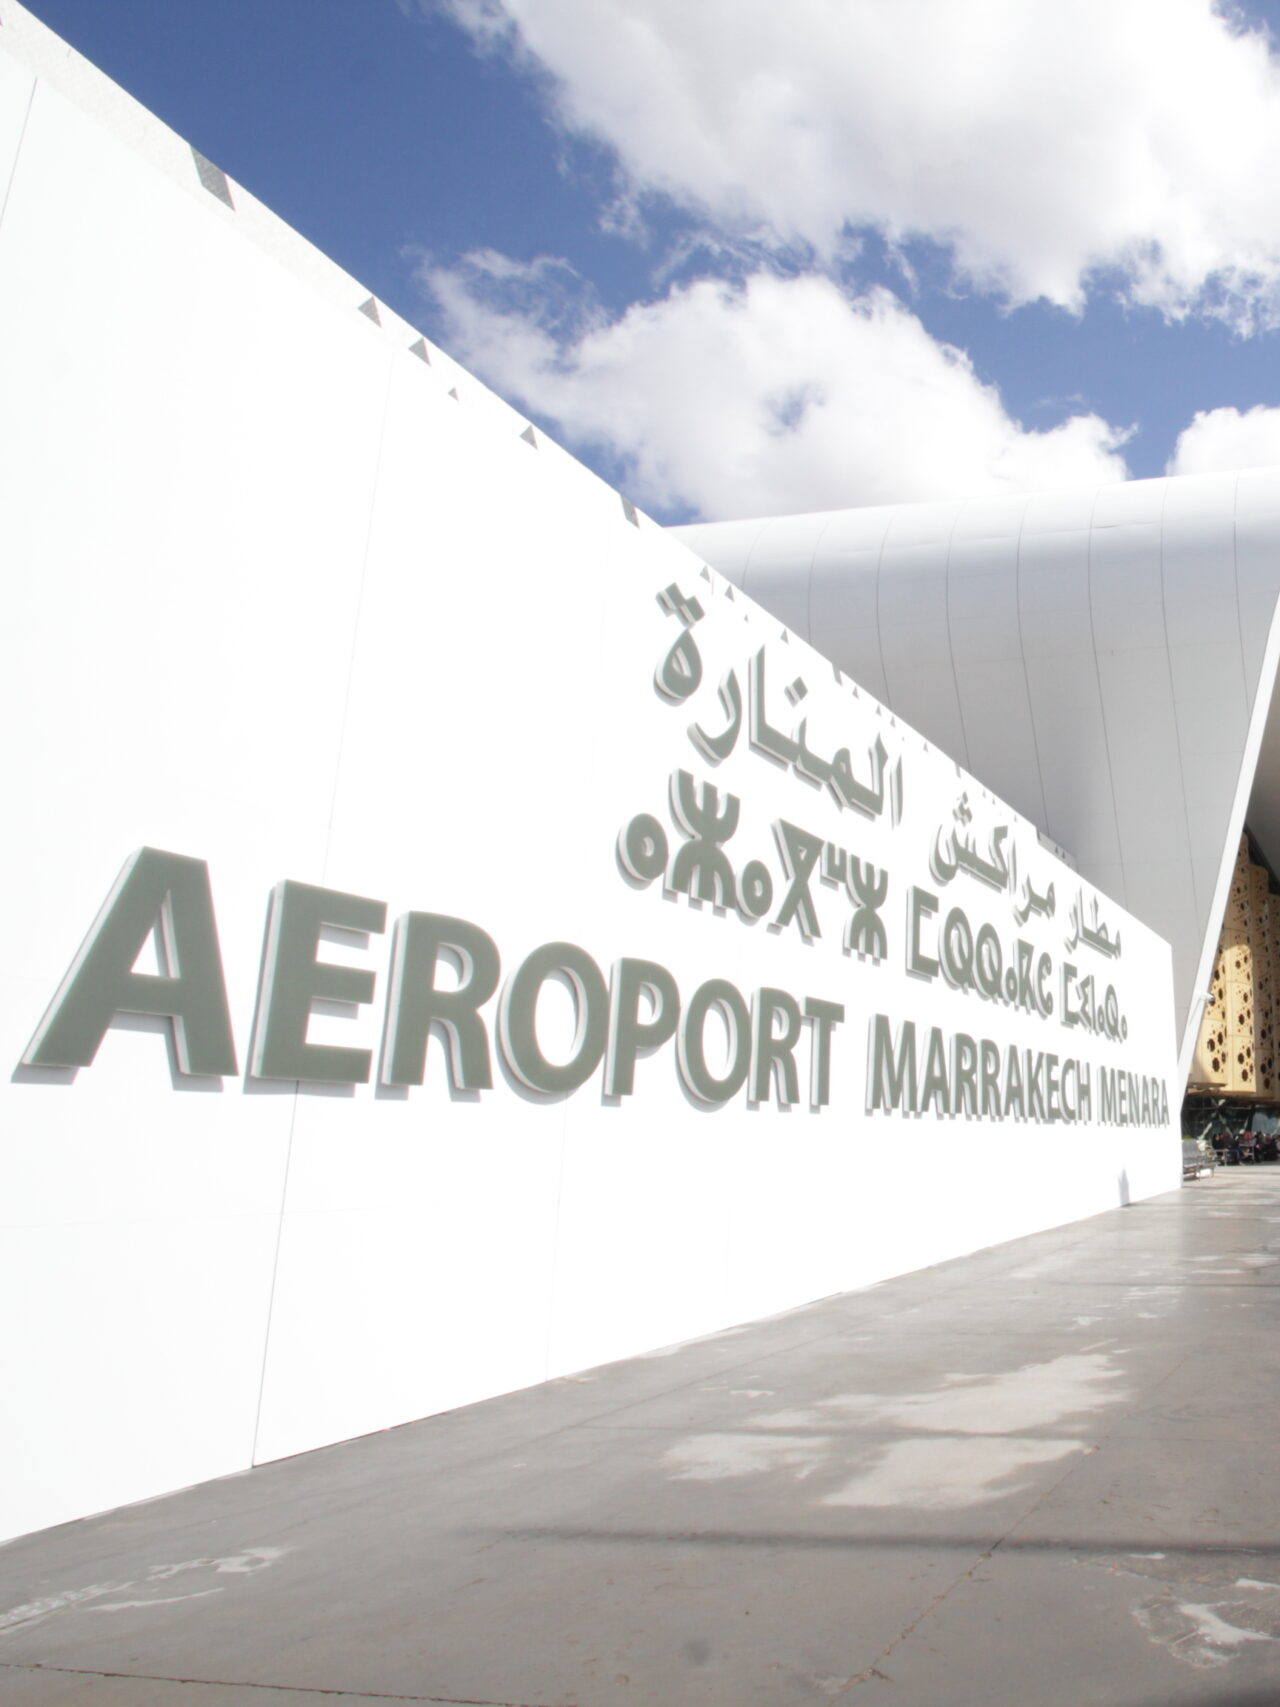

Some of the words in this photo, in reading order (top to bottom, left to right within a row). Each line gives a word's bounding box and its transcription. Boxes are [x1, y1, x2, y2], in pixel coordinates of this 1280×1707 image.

[654, 582, 903, 830] المنارة
[930, 791, 1055, 926] مراكش
[1064, 886, 1121, 957] مطار
[16, 846, 845, 1110] AEROPORT
[866, 1014, 1091, 1123] MARRAKECH
[1098, 1066, 1170, 1126] MENARA
